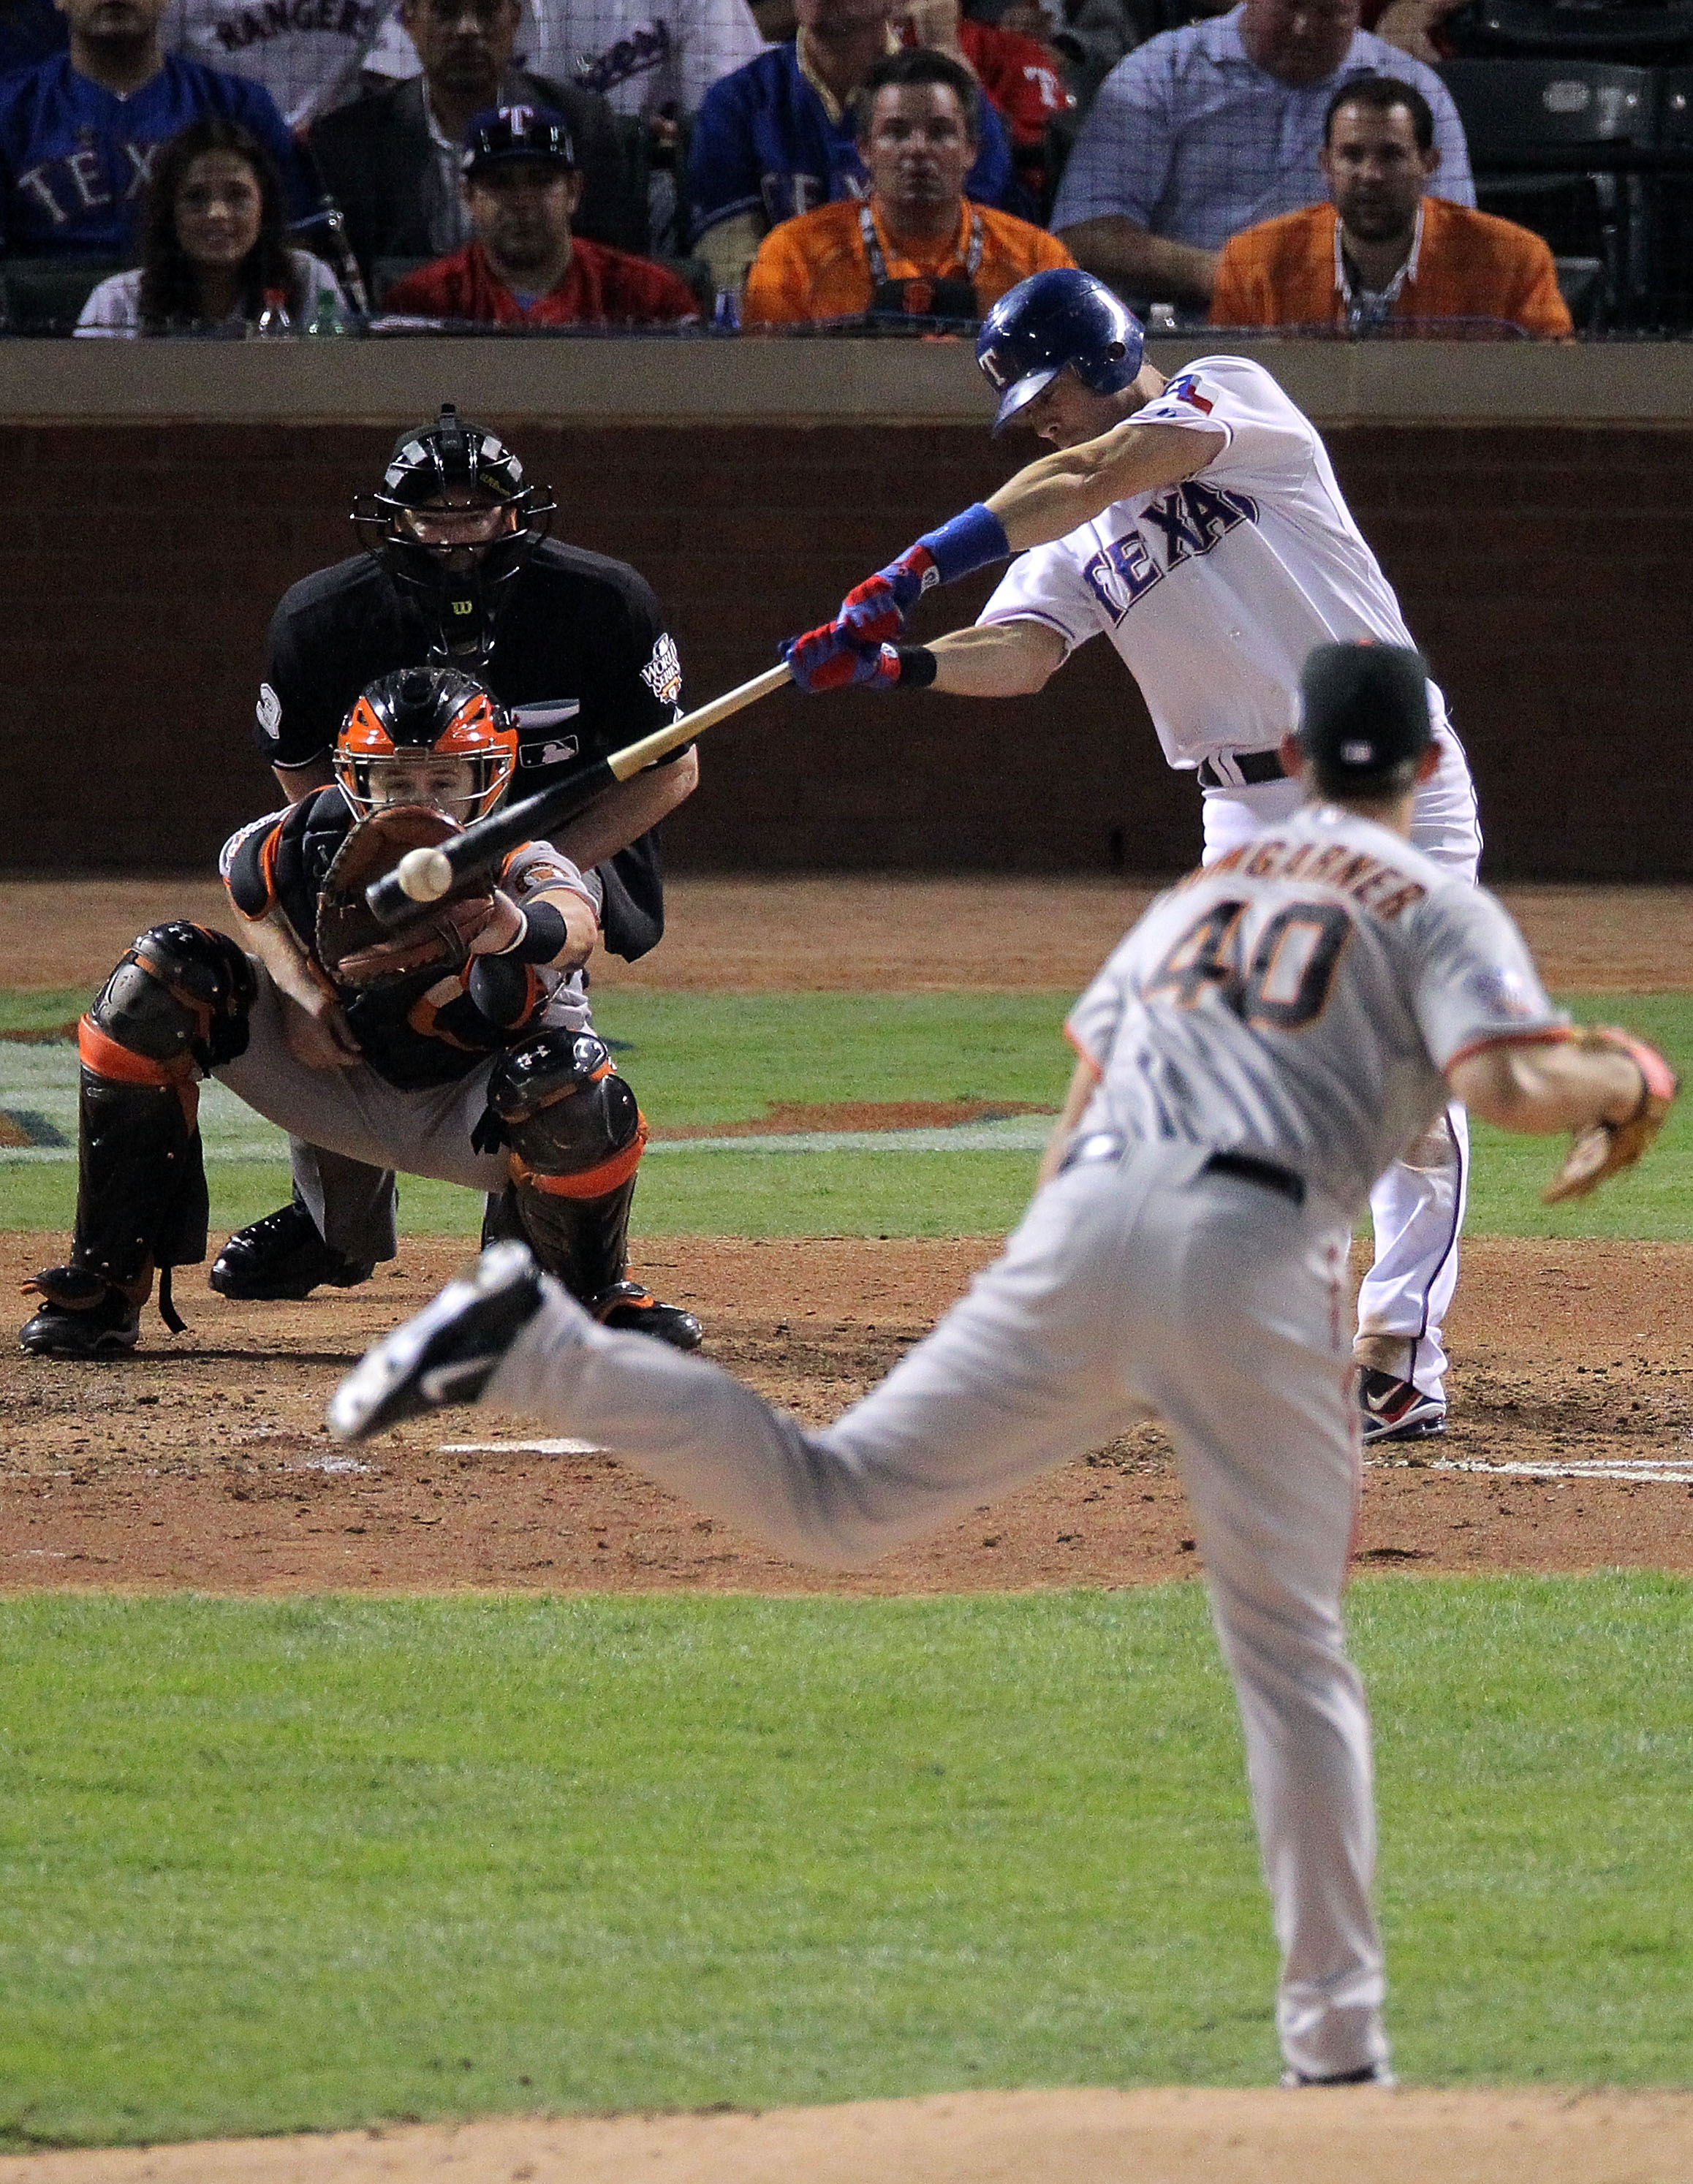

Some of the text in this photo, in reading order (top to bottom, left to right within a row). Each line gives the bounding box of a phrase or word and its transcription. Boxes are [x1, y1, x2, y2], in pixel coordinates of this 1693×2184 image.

[1023, 67, 1057, 107] T
[499, 105, 534, 136] T
[979, 347, 1006, 386] T
[1144, 898, 1354, 1032] 40
